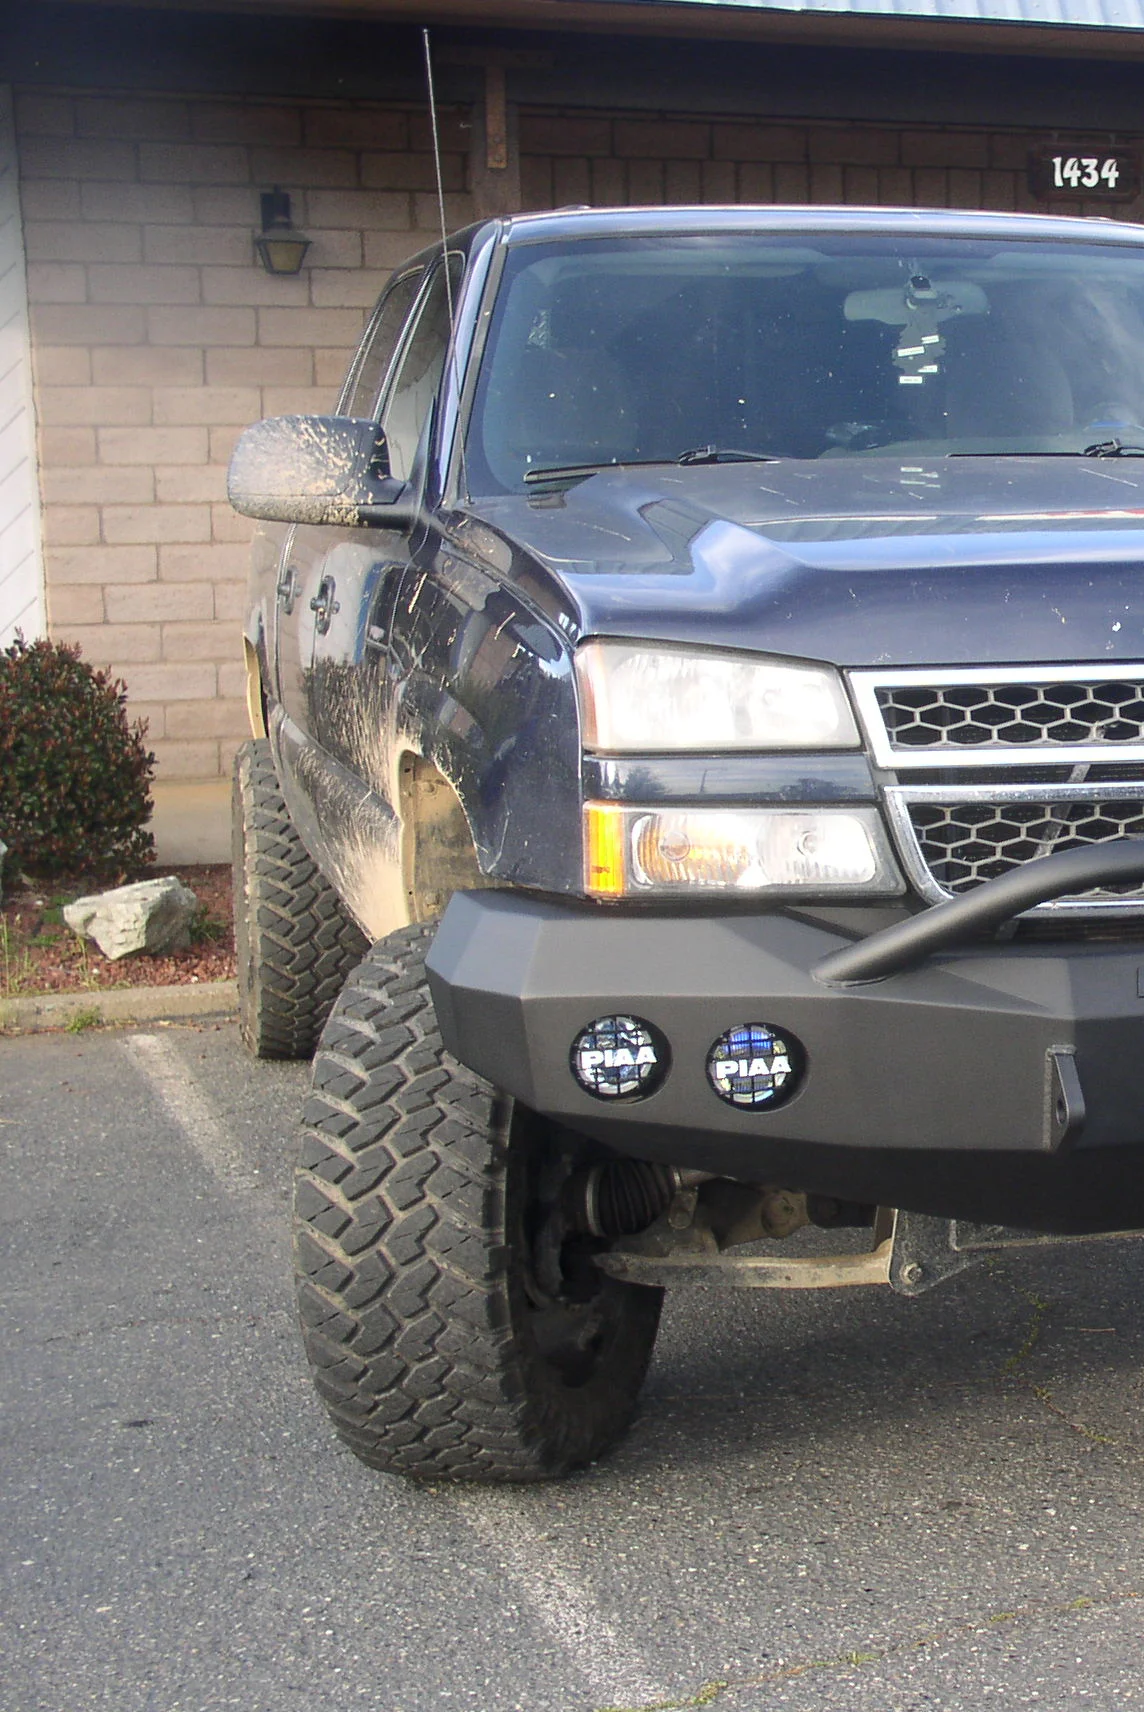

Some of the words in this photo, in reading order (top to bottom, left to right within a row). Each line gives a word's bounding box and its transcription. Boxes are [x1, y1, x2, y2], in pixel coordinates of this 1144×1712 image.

[1052, 157, 1119, 188] 1434
[580, 1046, 657, 1070] PIAA
[715, 1055, 792, 1080] PIAA
